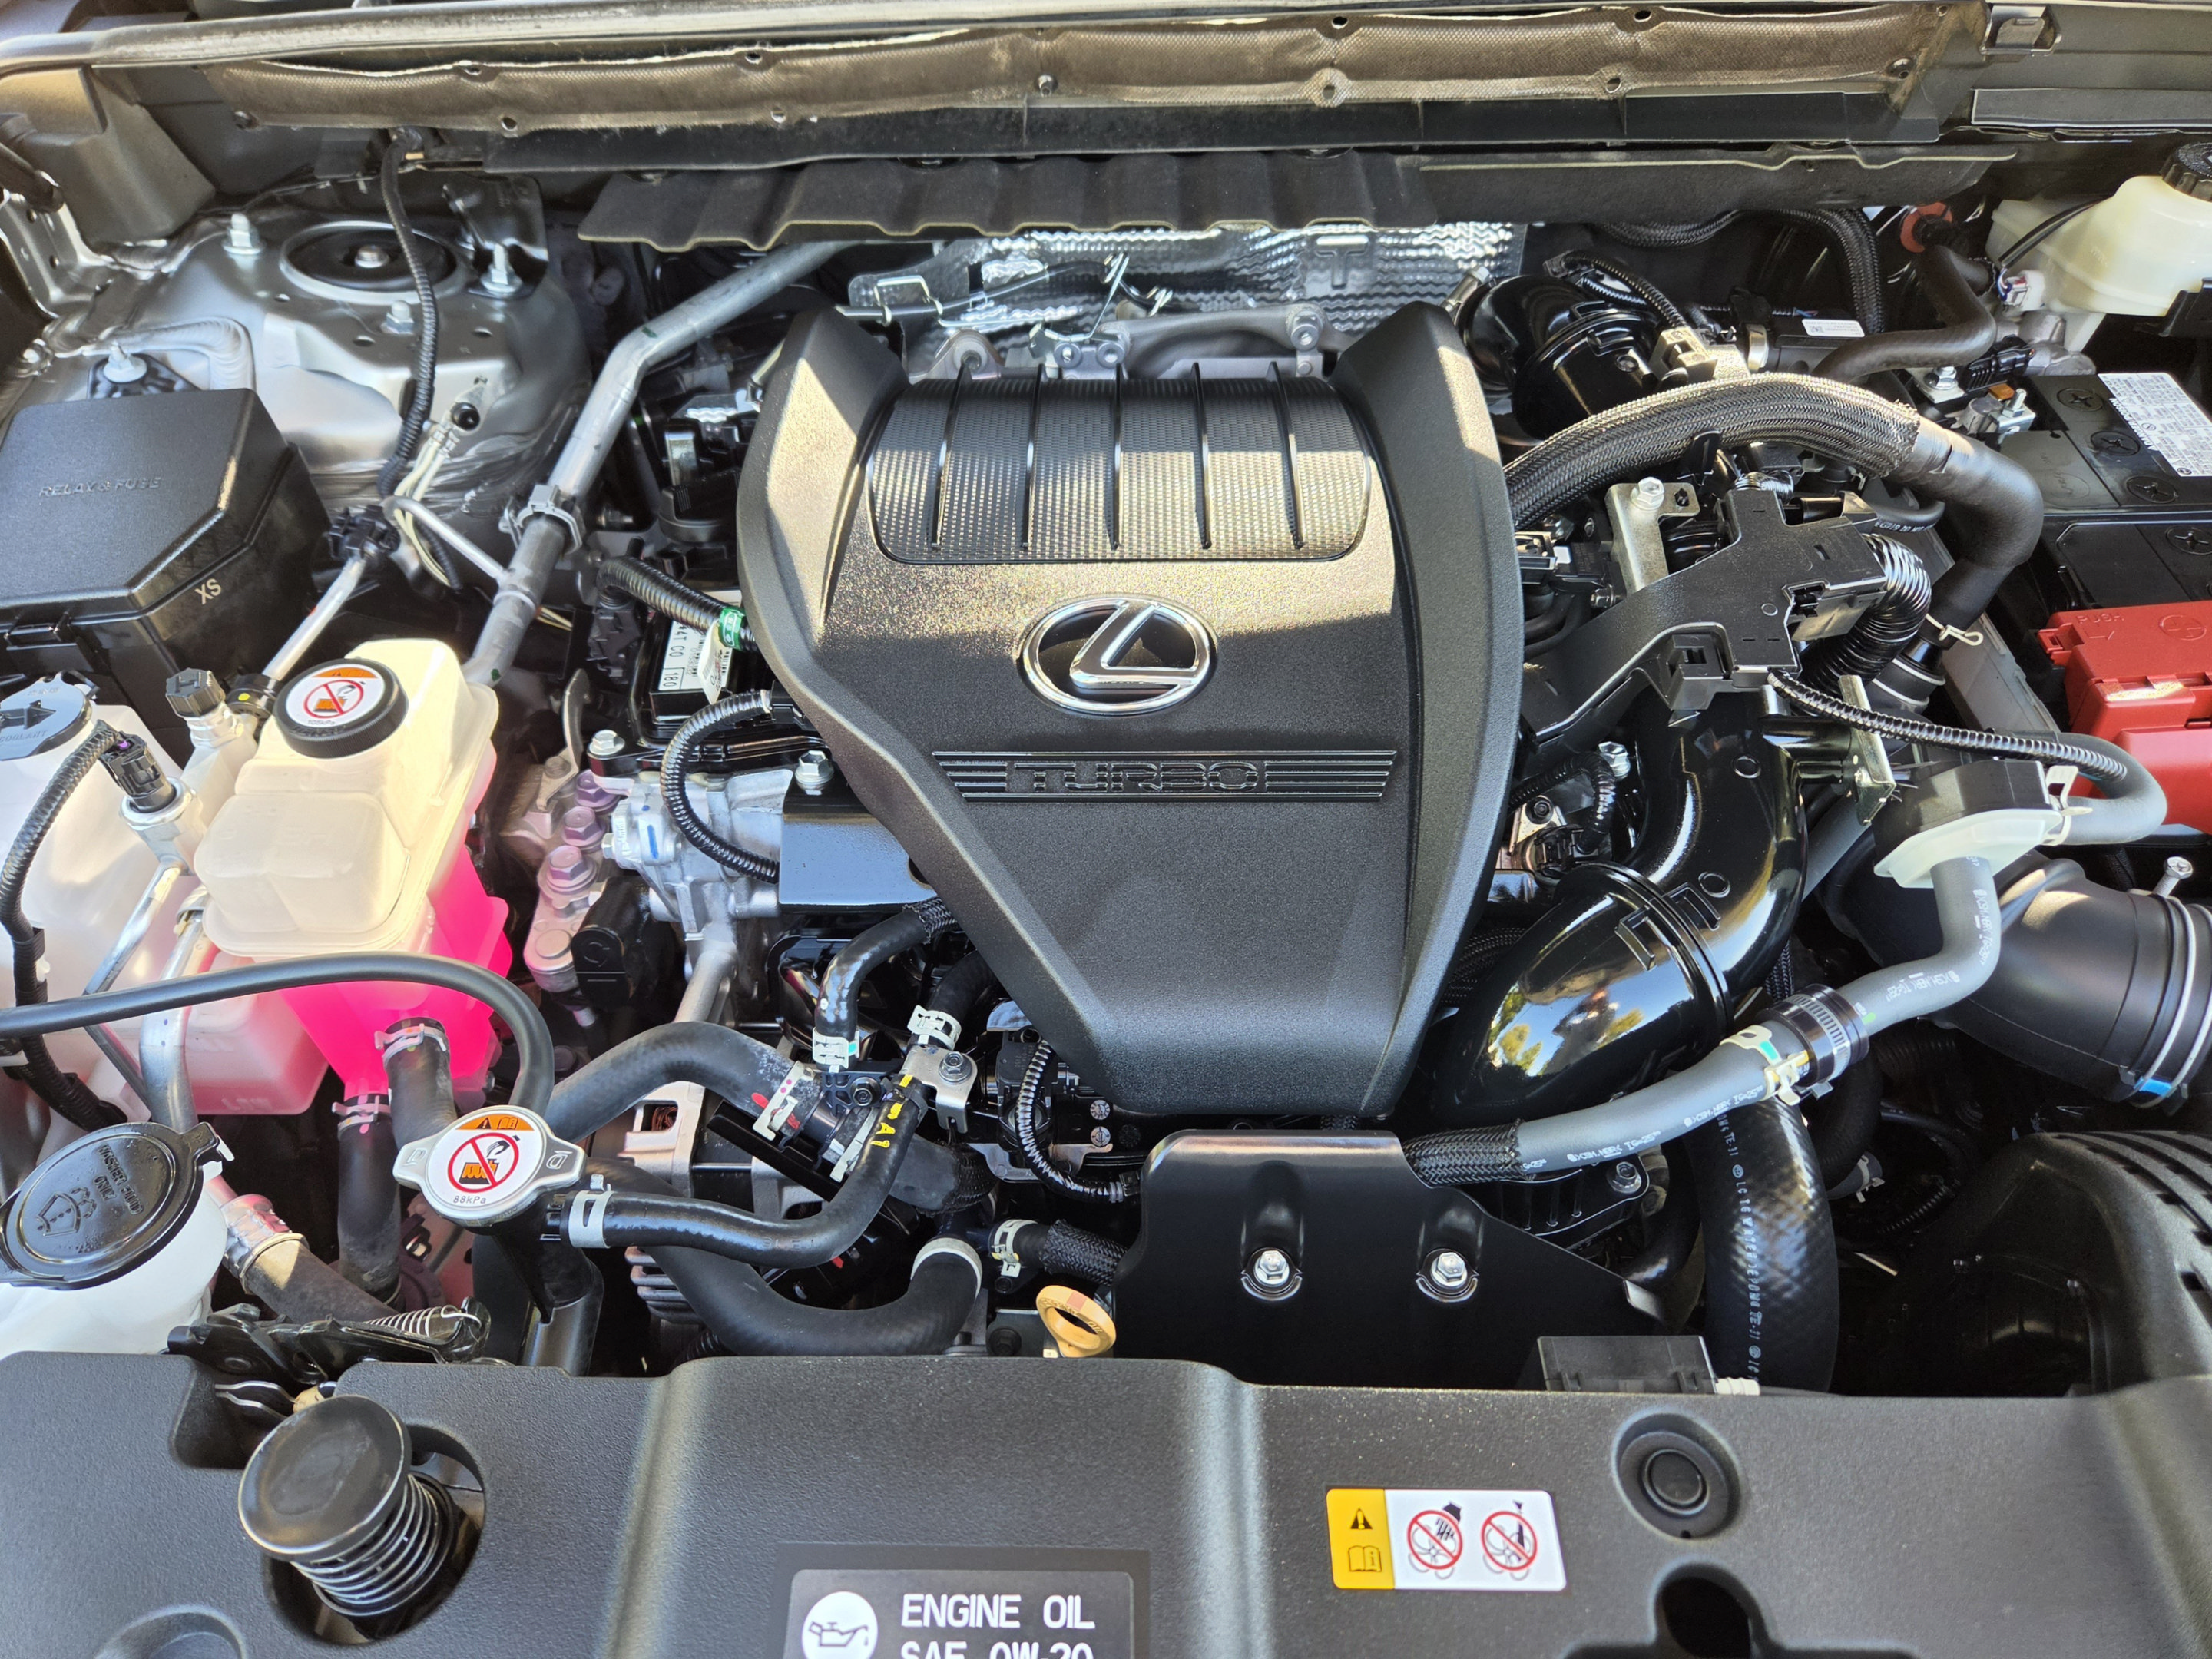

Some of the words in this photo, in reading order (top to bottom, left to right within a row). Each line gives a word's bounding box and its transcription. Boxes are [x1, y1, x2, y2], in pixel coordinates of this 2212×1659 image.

[39, 480, 98, 497] RELAY
[114, 476, 162, 492] FUSE
[194, 578, 221, 604] XS
[2076, 614, 2125, 624] PUSH
[663, 672, 679, 687] 180
[1014, 761, 1258, 793] TURBO
[94, 1175, 116, 1201] ONLY
[98, 1144, 127, 1185] WASHER
[121, 1185, 144, 1215] FLUID
[453, 1194, 487, 1204] 88kPa
[1742, 1217, 1758, 1260] WATER
[901, 1594, 1022, 1628] ENGINE
[1043, 1594, 1096, 1629] OIL
[900, 1641, 968, 1659] SAE
